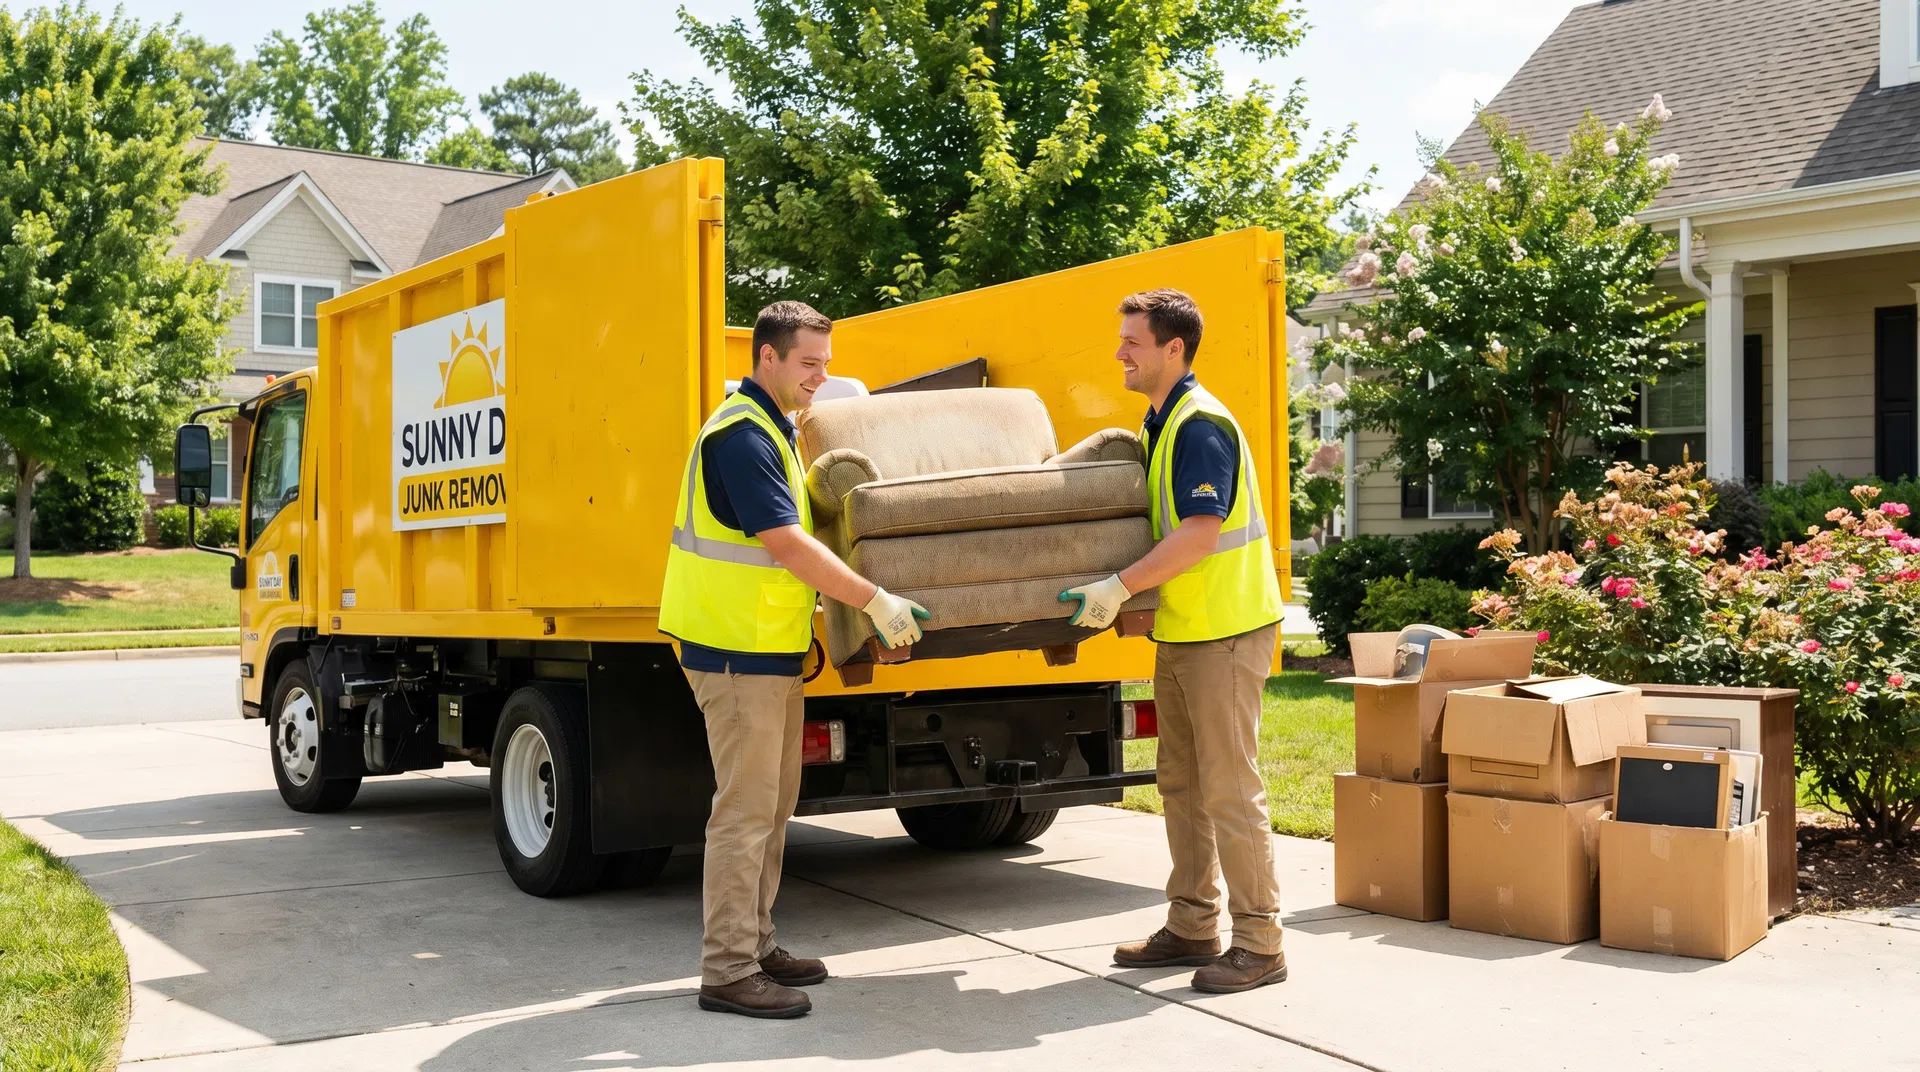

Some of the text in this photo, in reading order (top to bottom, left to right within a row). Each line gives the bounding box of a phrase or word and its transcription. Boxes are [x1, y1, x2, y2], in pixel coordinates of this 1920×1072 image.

[402, 407, 506, 467] SUNNY D
[403, 473, 506, 514] JUNK REMOV
